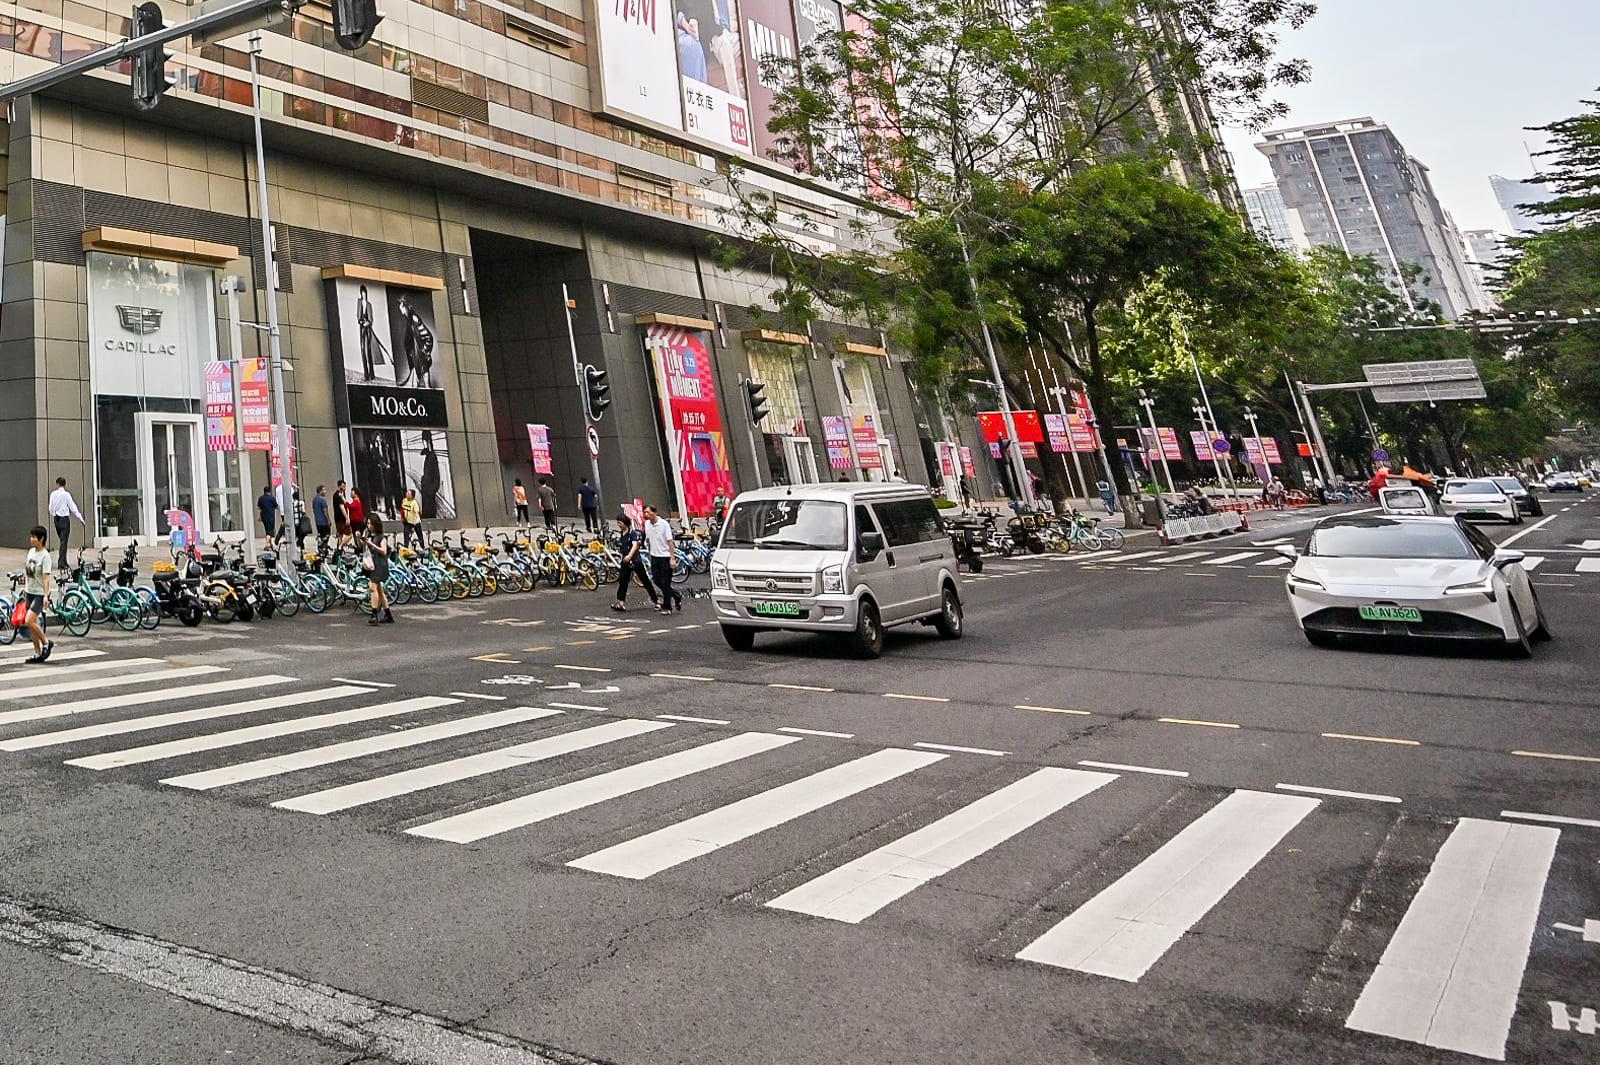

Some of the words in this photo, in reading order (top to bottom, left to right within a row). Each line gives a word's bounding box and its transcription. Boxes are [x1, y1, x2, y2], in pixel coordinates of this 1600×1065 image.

[686, 86, 715, 112] 优衣库
[104, 338, 177, 356] CADILLAC
[370, 395, 429, 417] MO&Co.
